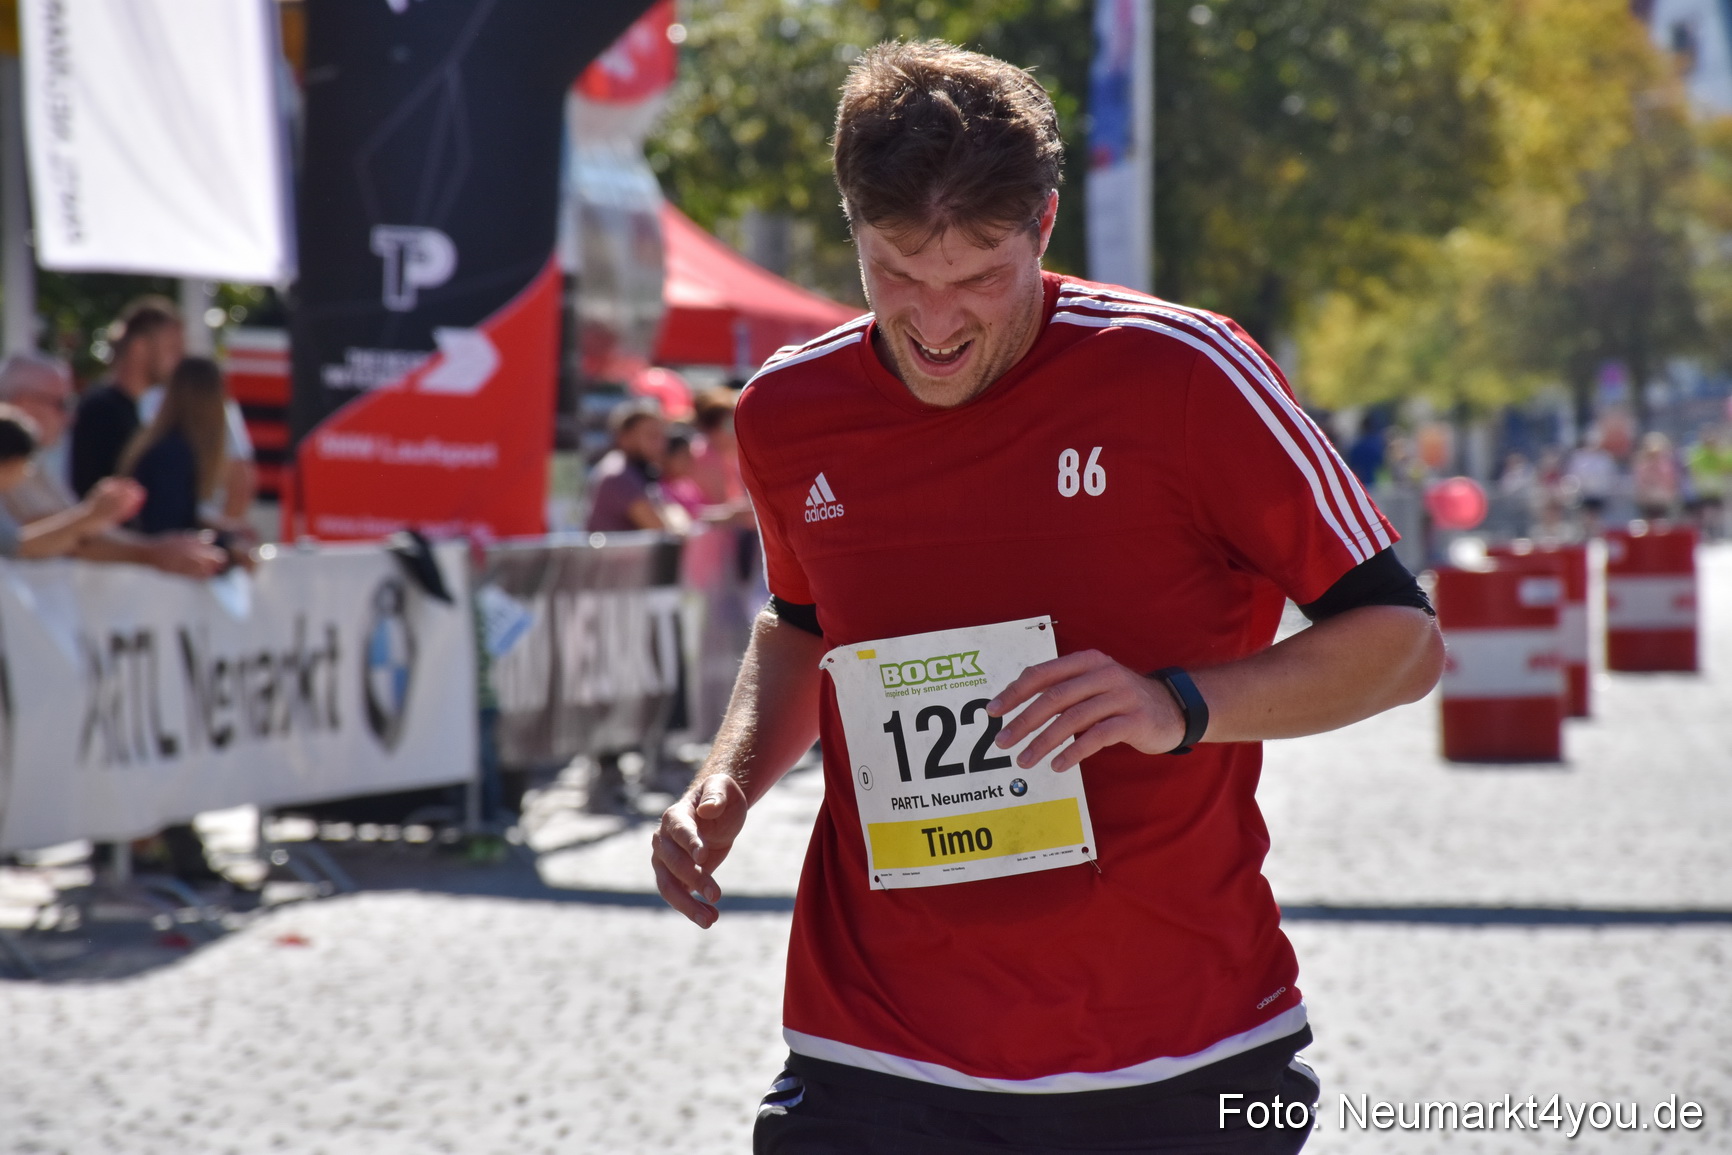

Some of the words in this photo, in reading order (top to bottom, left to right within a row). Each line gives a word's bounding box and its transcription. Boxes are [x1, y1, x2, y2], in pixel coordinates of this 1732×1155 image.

[1057, 446, 1106, 498] 86
[804, 501, 844, 523] adidas
[880, 650, 985, 688] BOCK
[885, 688, 910, 698] inspired
[911, 686, 921, 695] by
[923, 683, 948, 693] smart
[949, 678, 988, 689] concepts
[883, 698, 1012, 782] 122
[891, 795, 929, 811] PARTL
[932, 785, 1004, 806] Neumarkt
[921, 826, 993, 857] Timo
[1256, 986, 1287, 1010] adizero
